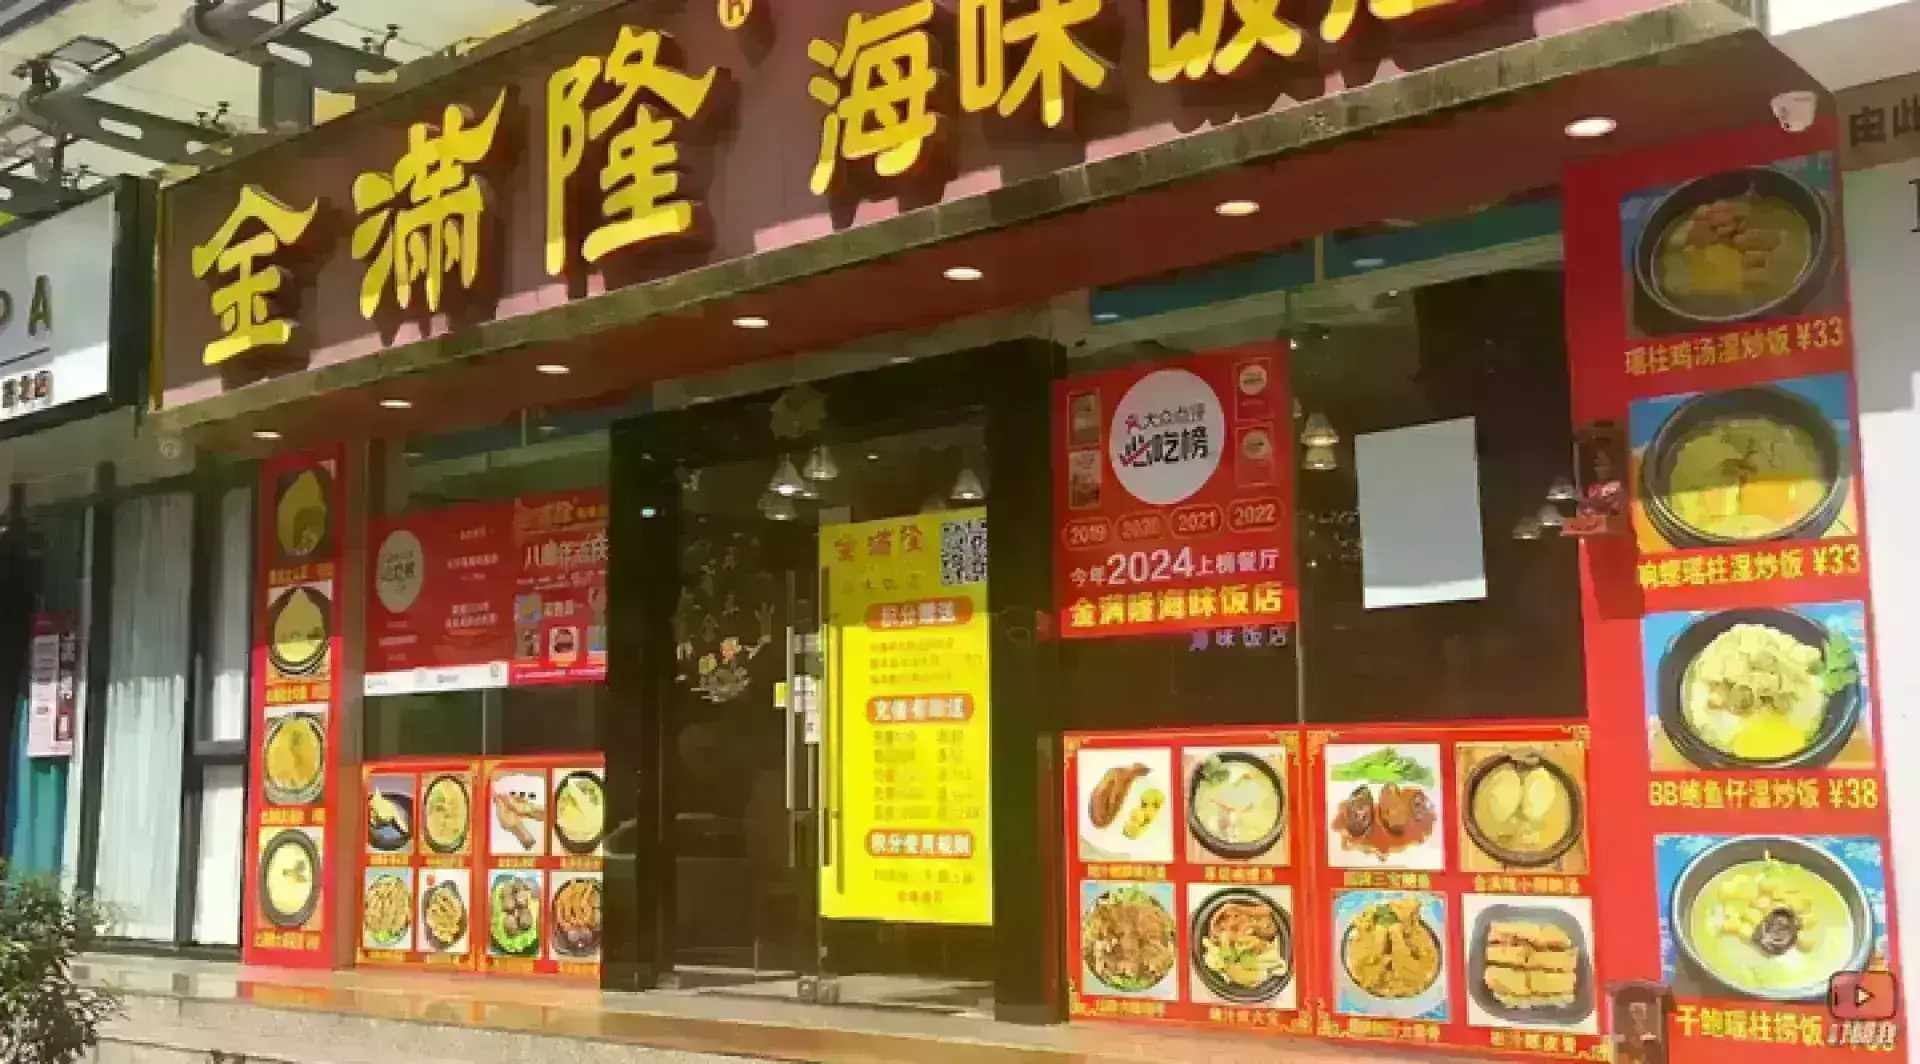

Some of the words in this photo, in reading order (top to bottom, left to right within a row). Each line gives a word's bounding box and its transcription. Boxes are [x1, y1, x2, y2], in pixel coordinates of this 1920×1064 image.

[1796, 316, 1844, 350] ¥33
[1118, 426, 1209, 468] 必吃榜
[1177, 508, 1216, 533] 2021
[1233, 503, 1276, 526] 2022
[1812, 543, 1862, 576] ¥33
[1828, 777, 1879, 809] ¥38
